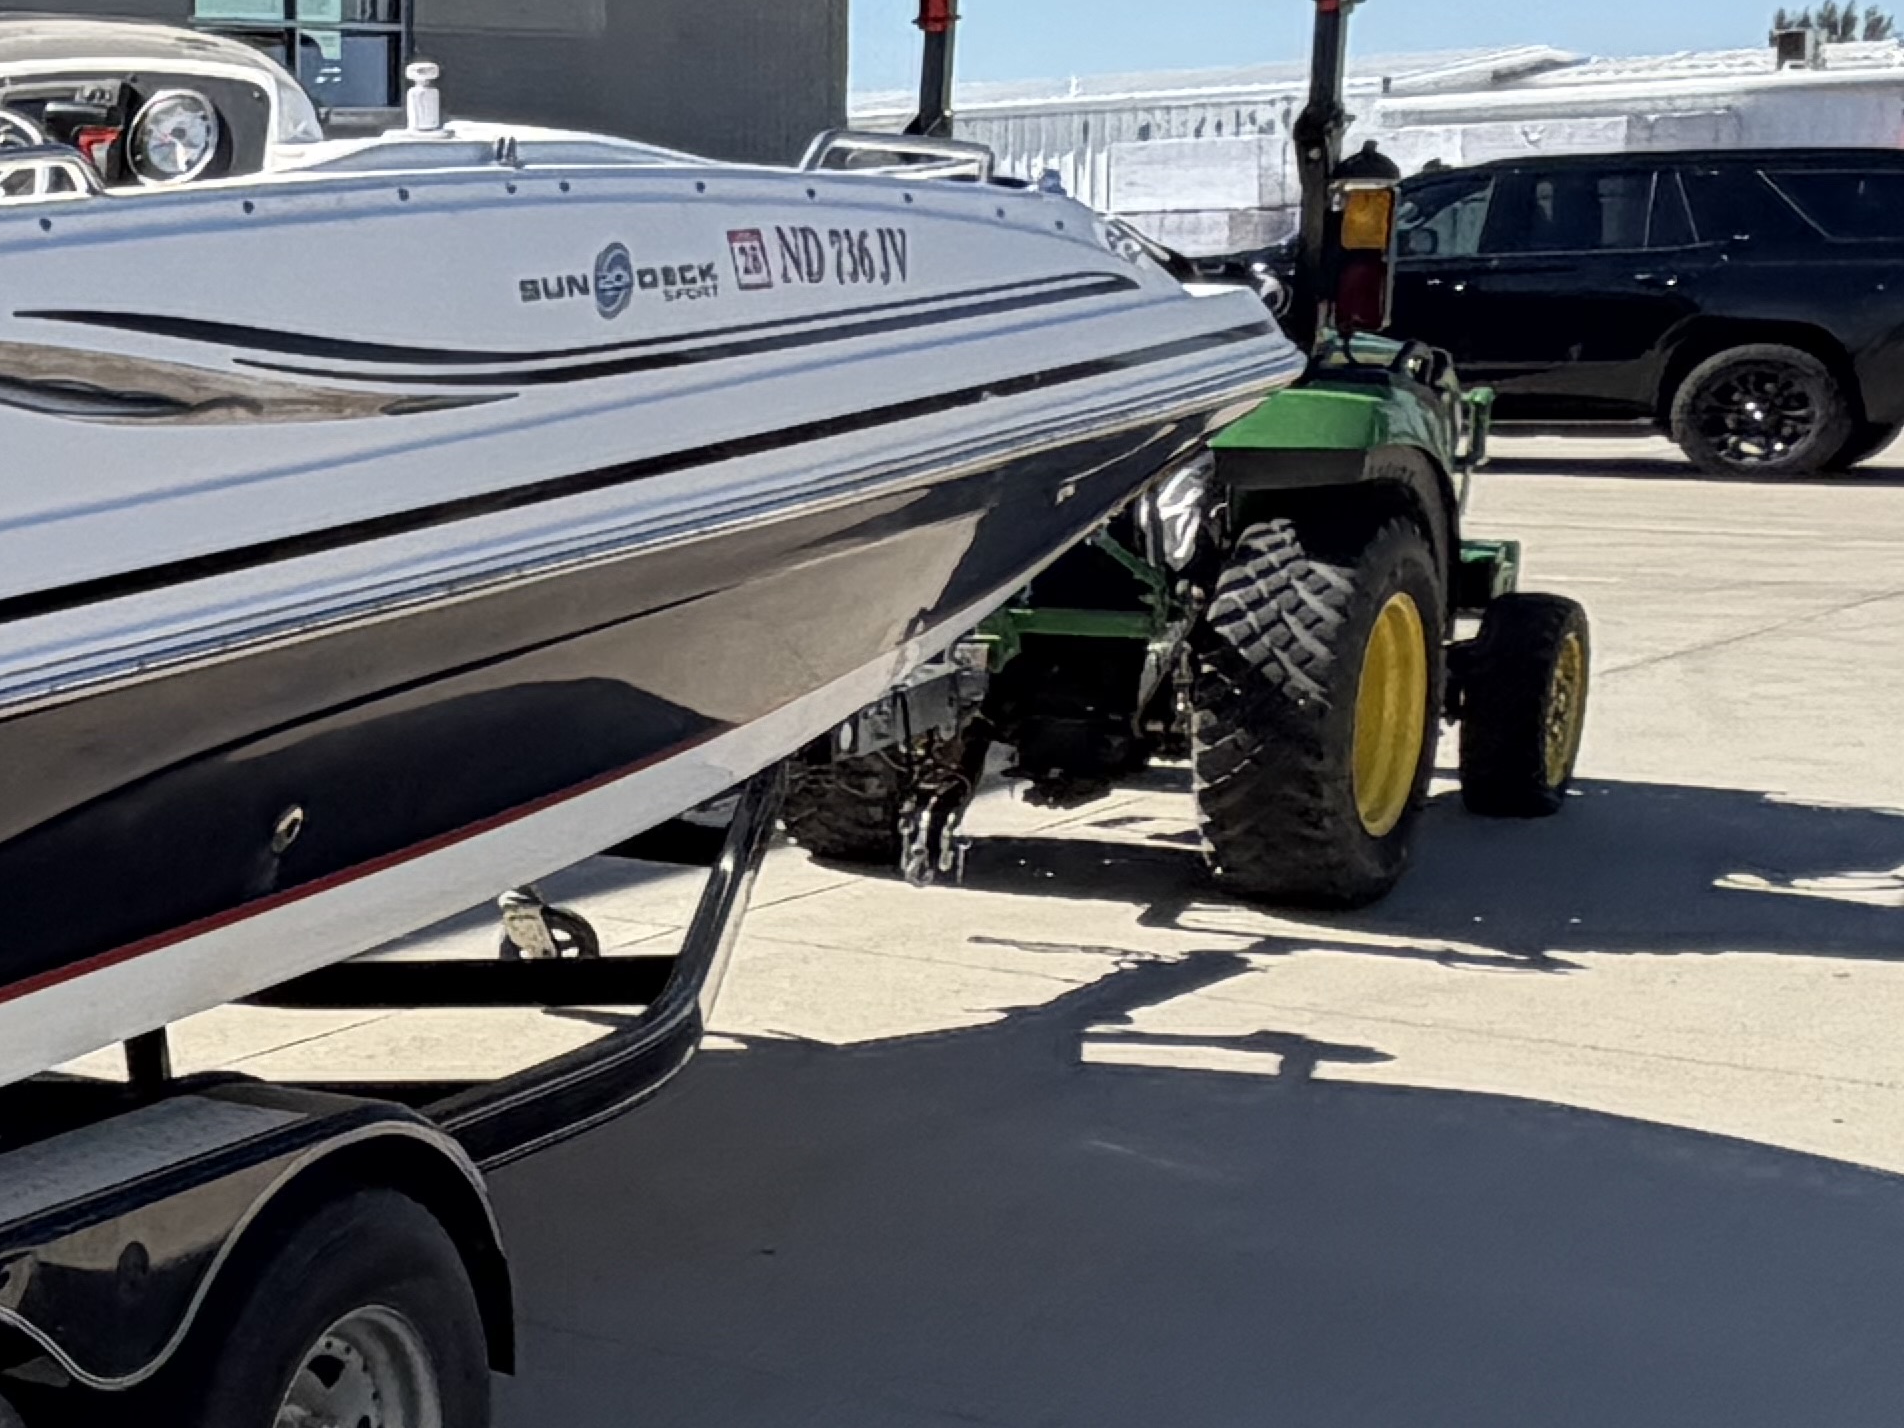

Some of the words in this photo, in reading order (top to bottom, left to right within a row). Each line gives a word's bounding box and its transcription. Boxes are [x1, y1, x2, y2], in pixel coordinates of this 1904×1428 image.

[774, 225, 826, 285] ND
[875, 226, 908, 286] JV
[518, 272, 591, 303] SUN
[635, 261, 720, 290] DECK
[662, 283, 720, 302] SPORT
